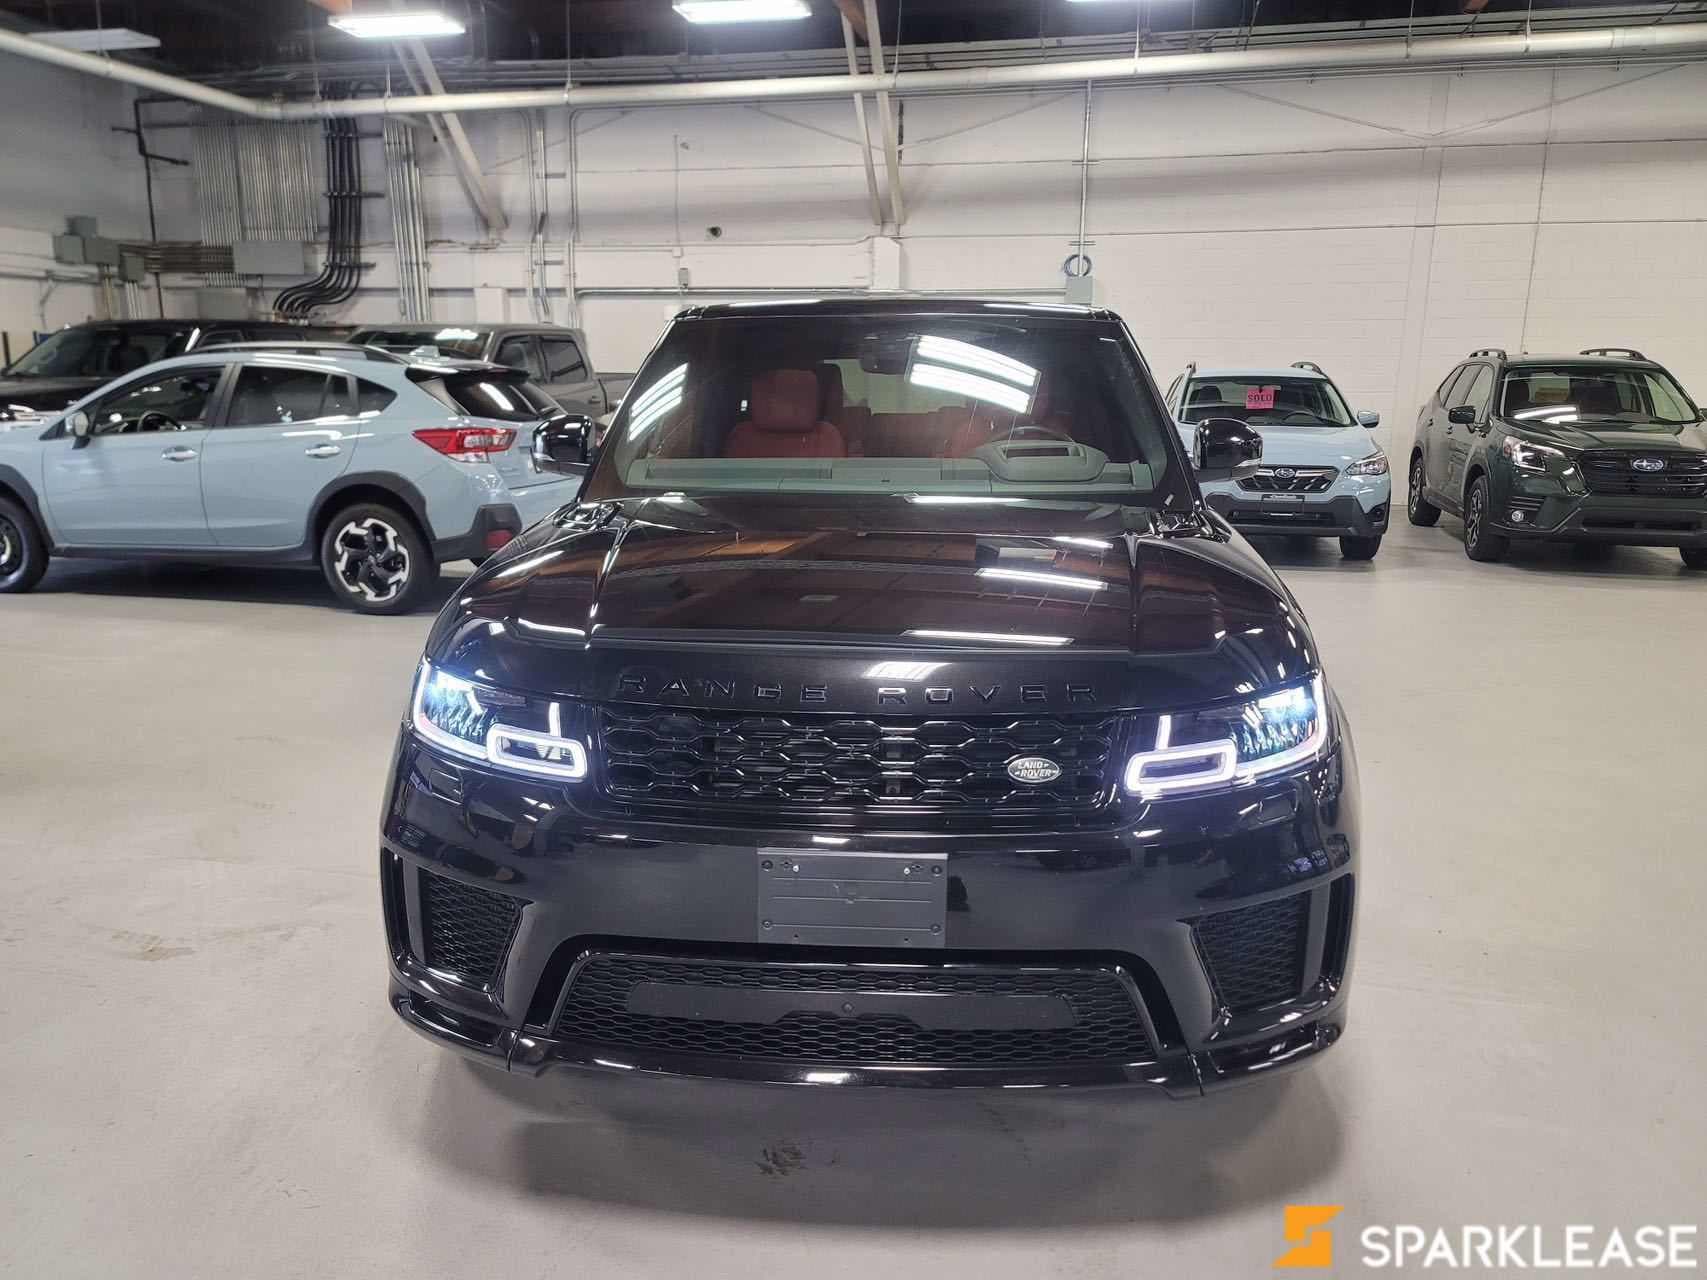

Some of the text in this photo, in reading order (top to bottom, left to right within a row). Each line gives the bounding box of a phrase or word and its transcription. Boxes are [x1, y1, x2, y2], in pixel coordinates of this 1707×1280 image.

[1247, 393, 1272, 401] SOLD
[617, 673, 1098, 704] RANGE ROVER
[1018, 760, 1043, 769] LAND
[1020, 769, 1052, 777] ROVER
